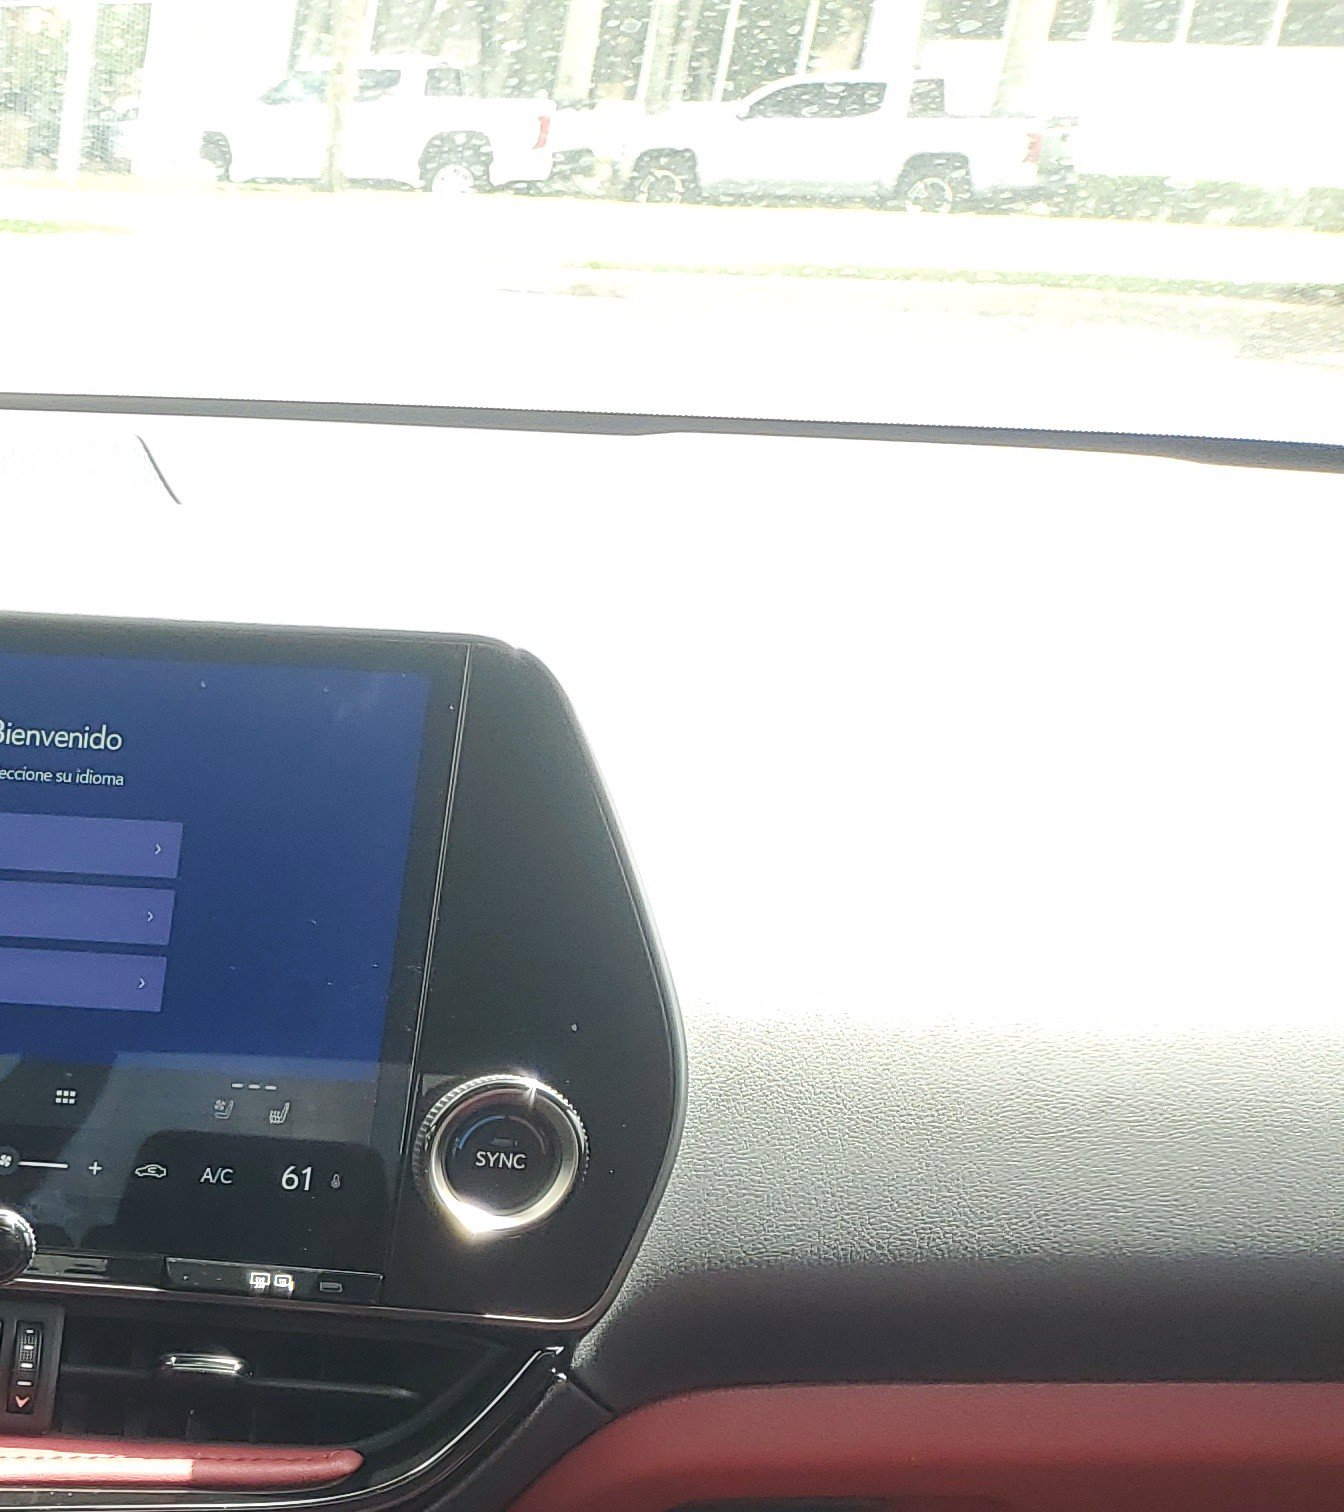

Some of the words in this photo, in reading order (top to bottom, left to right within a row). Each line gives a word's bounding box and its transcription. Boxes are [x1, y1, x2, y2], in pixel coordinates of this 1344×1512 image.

[55, 768, 73, 784] su
[75, 767, 124, 787] idioma
[474, 1150, 528, 1171] SYNC
[199, 1166, 234, 1185] A/C
[280, 1166, 312, 1193] 61
